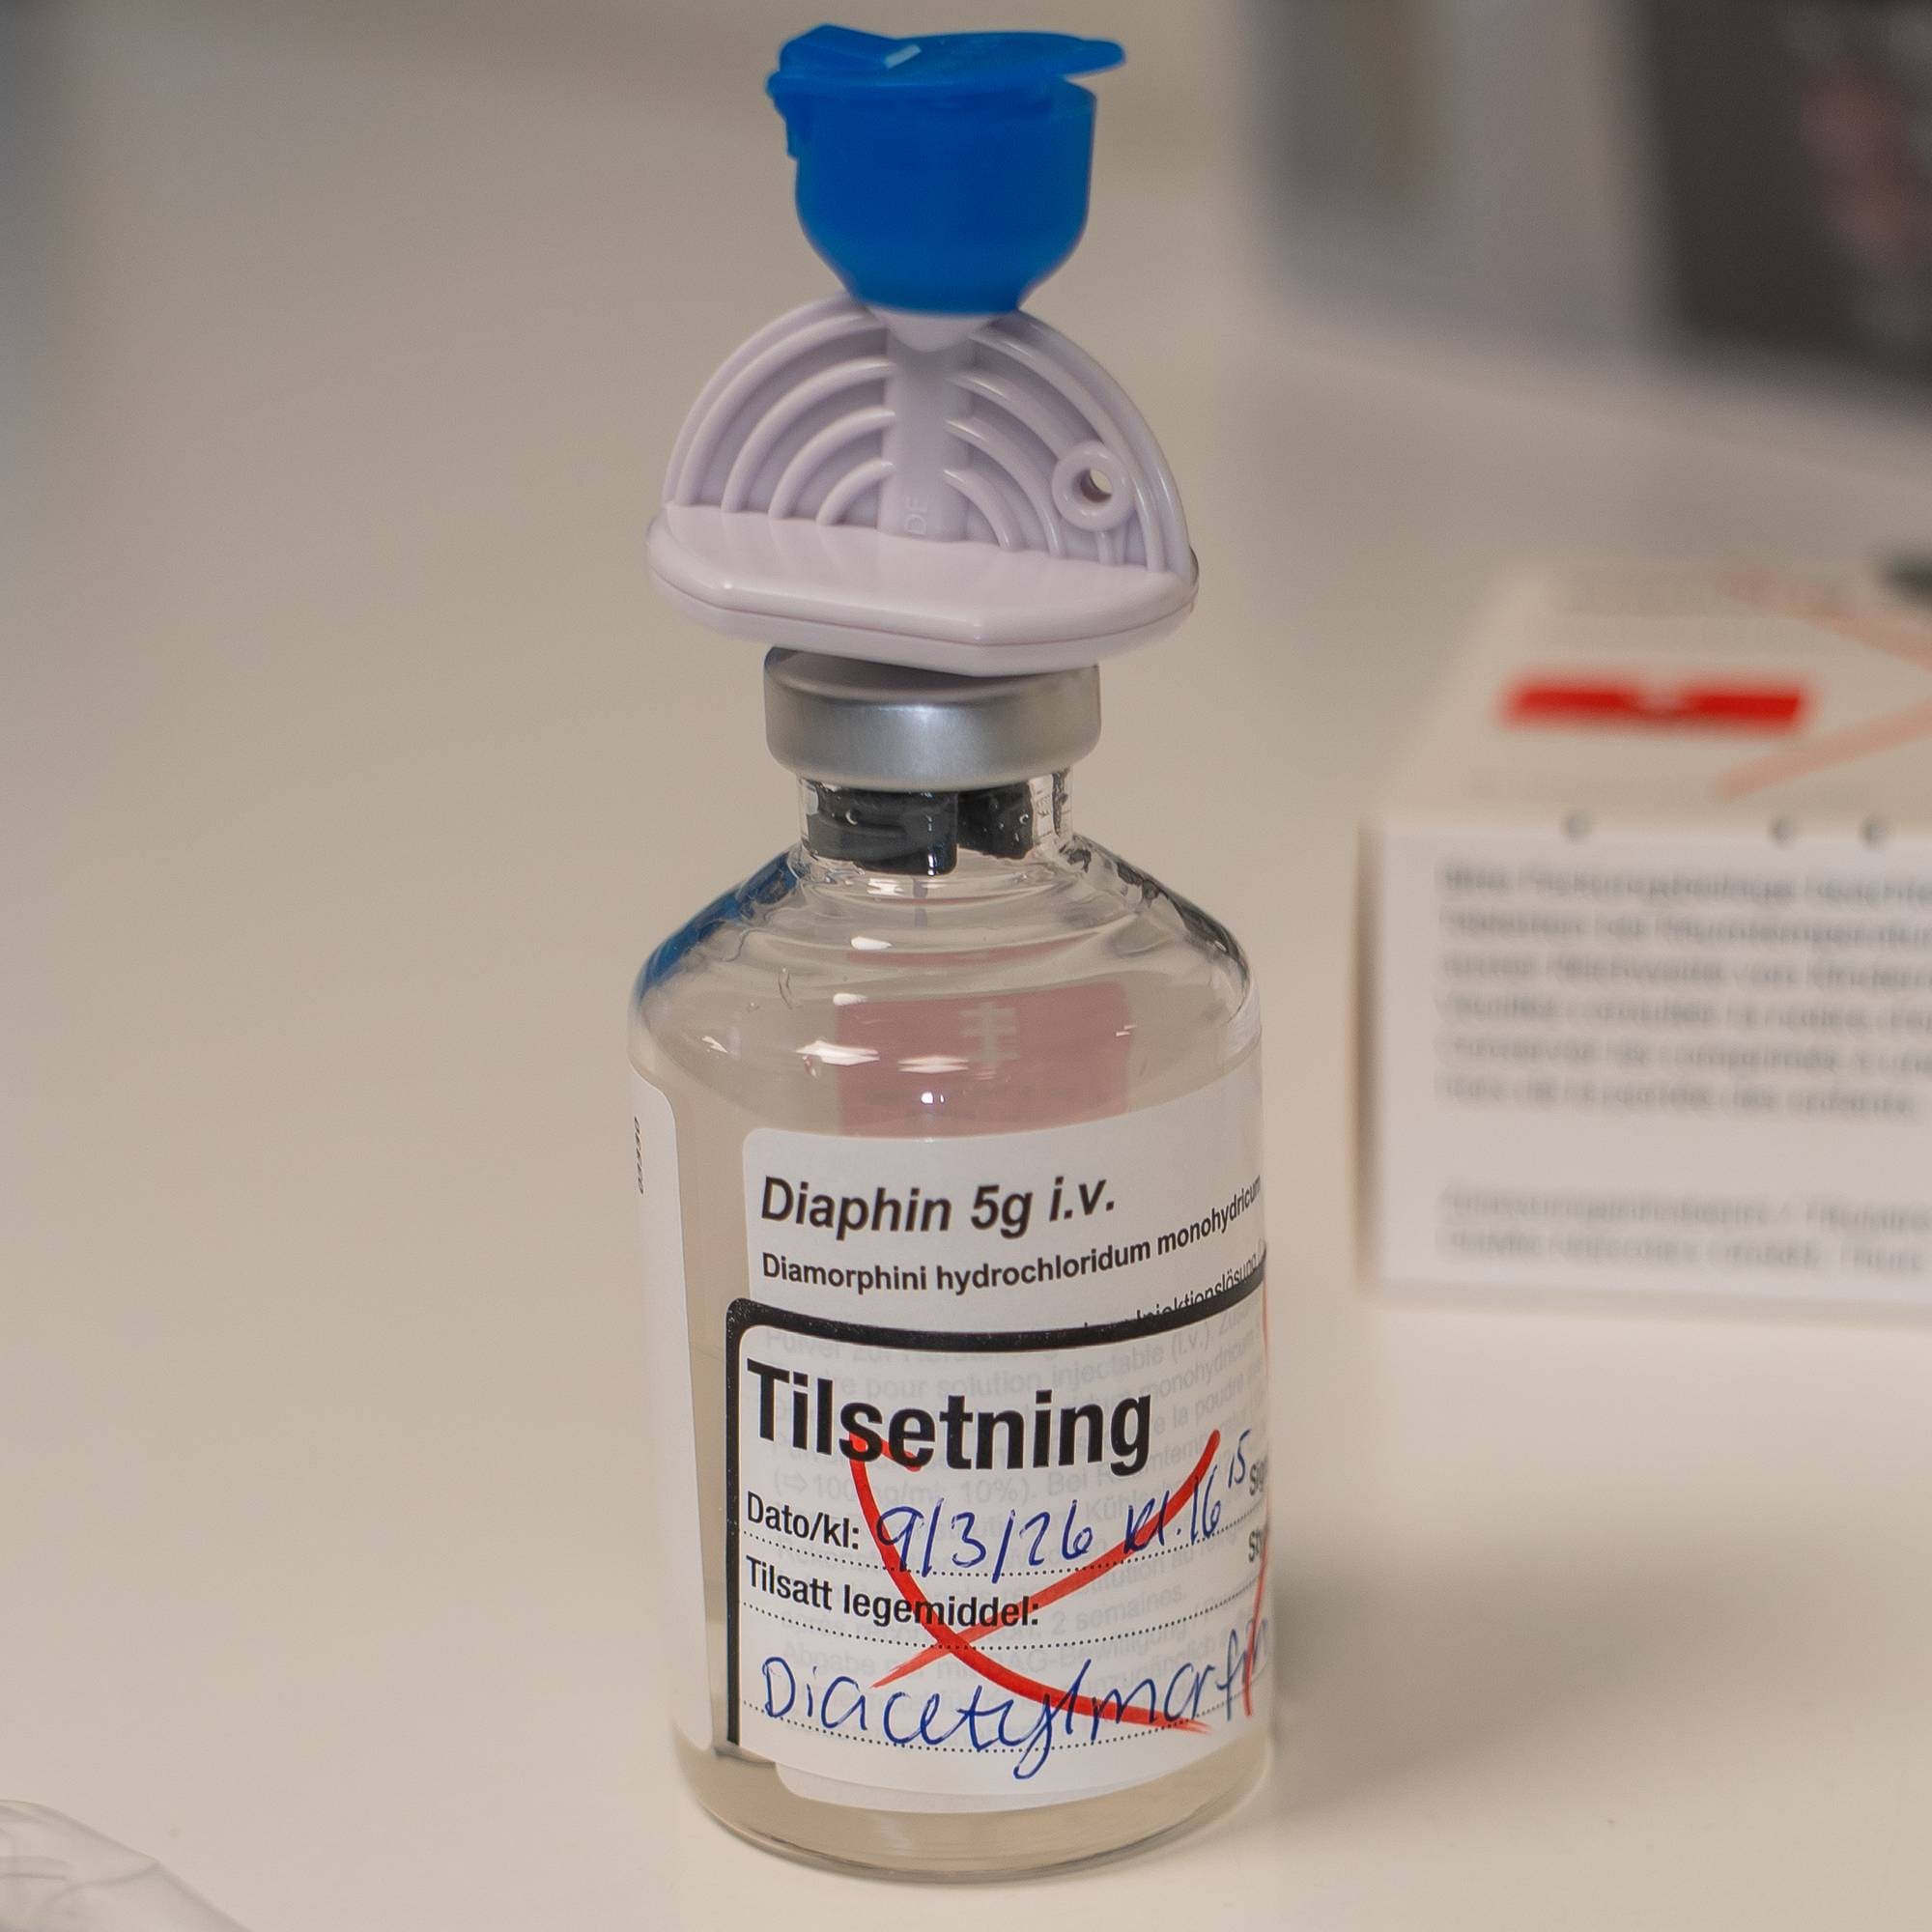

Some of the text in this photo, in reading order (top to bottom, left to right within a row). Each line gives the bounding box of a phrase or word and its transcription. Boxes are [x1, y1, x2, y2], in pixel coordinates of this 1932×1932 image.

[761, 1176, 1116, 1240] Diaphin 5g i.v.
[762, 1174, 1262, 1295] Diamorphini hydrochloridum monohydricum
[746, 1356, 1151, 1477] Tilsetning
[747, 1490, 860, 1550] Dato/kl:
[745, 1554, 833, 1611] Tilsatt
[843, 1584, 1039, 1628] legemiddel:
